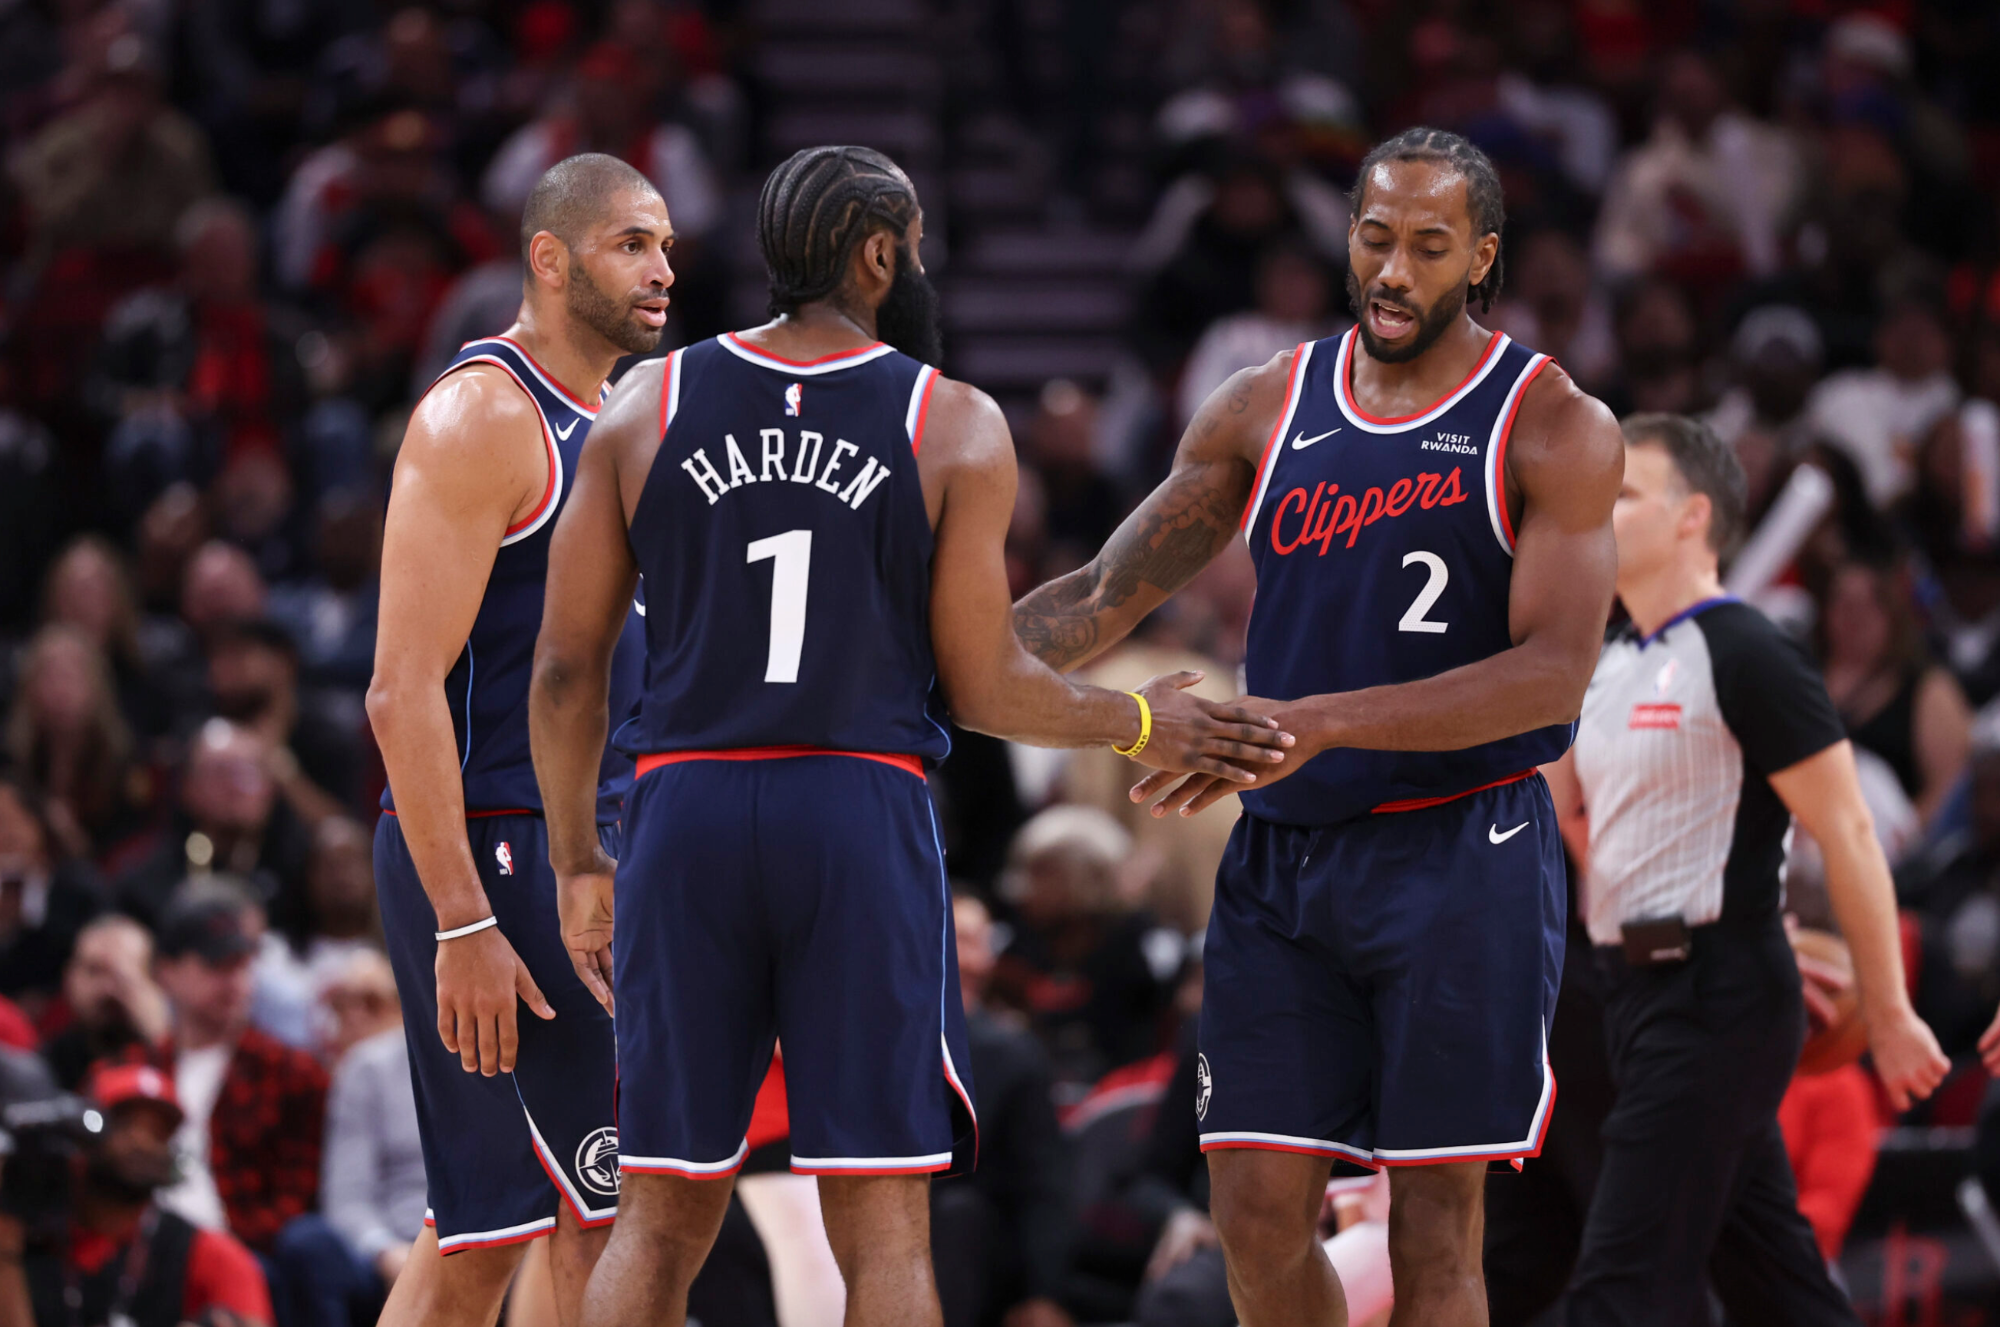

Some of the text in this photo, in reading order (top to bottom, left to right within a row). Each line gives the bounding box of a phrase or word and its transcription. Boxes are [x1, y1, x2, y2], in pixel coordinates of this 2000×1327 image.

[681, 428, 891, 510] HARDEN
[1421, 440, 1478, 455] RWANDA
[1437, 432, 1470, 445] VISIT
[1271, 466, 1469, 557] Clippers
[747, 530, 812, 683] 1
[1398, 551, 1449, 633] 2
